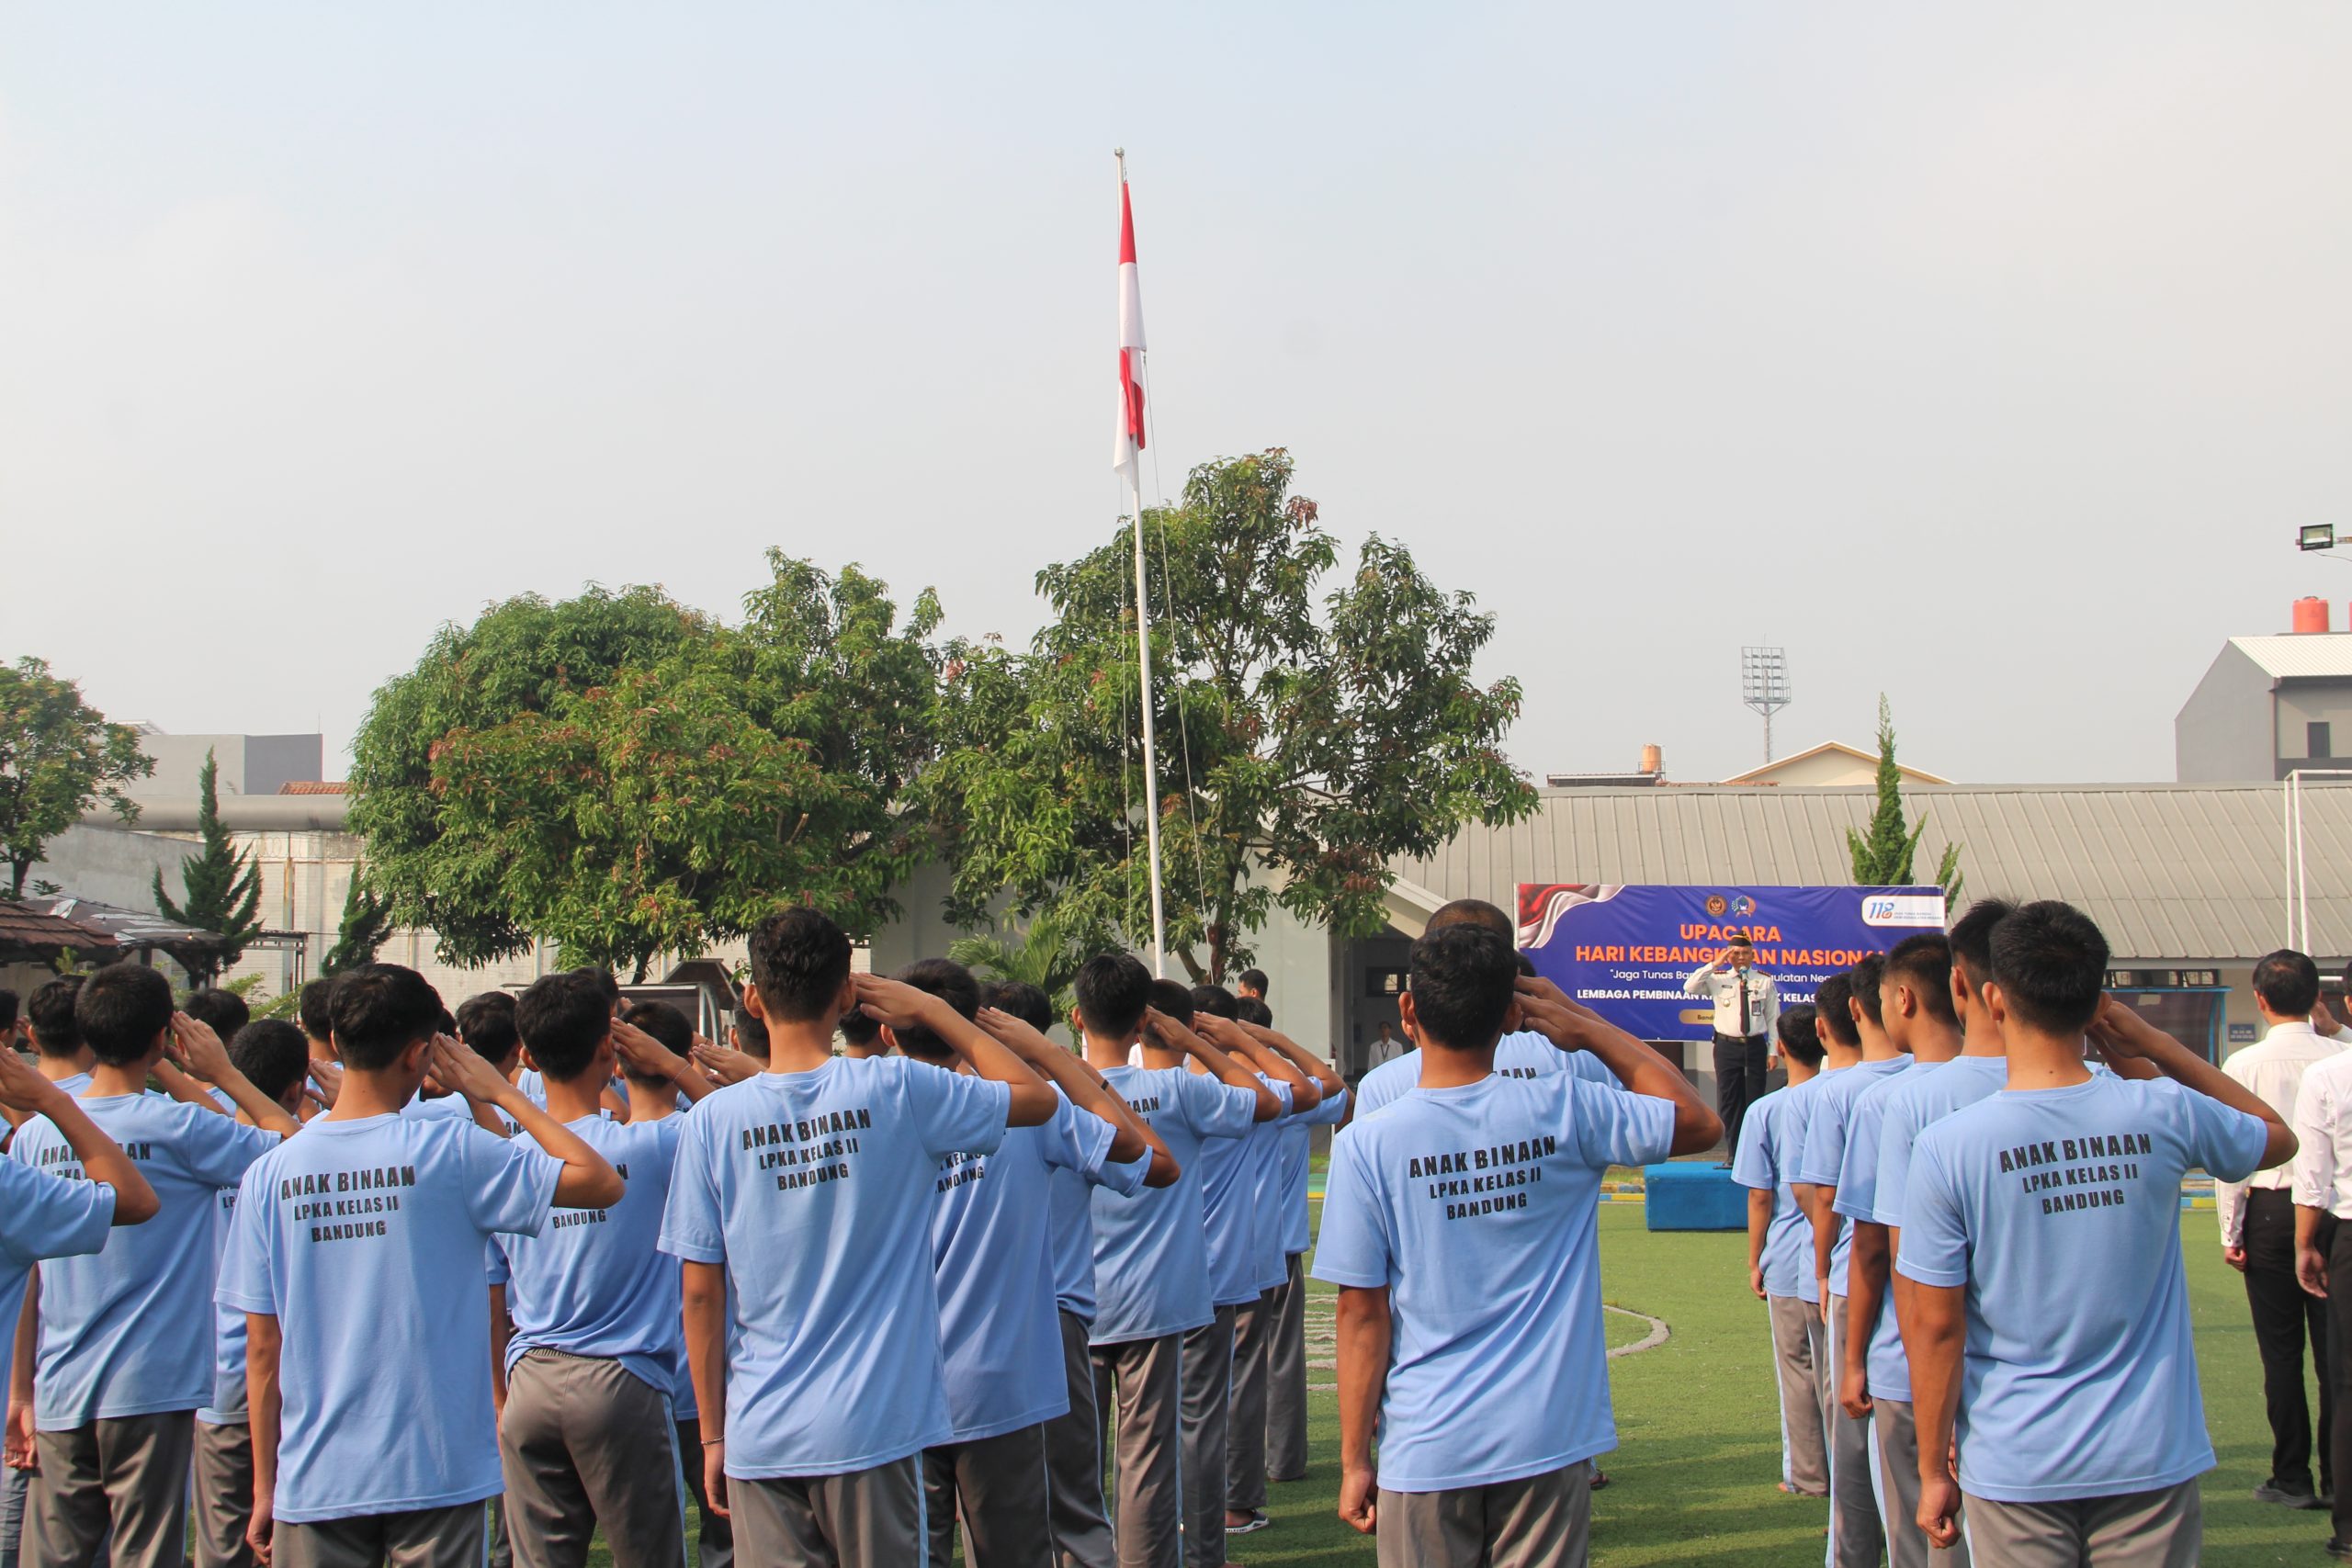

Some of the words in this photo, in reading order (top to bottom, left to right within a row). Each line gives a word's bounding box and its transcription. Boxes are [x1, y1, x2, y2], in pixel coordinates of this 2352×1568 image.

[1869, 902, 1894, 919] 118
[1576, 945, 1624, 962] HARI
[1781, 949, 1884, 965] NASION
[1642, 970, 1673, 979] Tunas
[1577, 989, 1631, 999] LEMBAGA
[742, 1123, 794, 1150] ANAK
[797, 1109, 871, 1142] BINAAN
[759, 1150, 797, 1170] LPKA
[800, 1140, 843, 1164] KELAS
[846, 1138, 858, 1153] II
[1409, 1152, 1468, 1178] ANAK
[1475, 1135, 1555, 1169] BINAAN
[1999, 1141, 2058, 1173] ANAK
[2062, 1134, 2152, 1161] BINAAN
[281, 1173, 331, 1200] ANAK
[337, 1166, 415, 1191] BINAAN
[777, 1163, 849, 1190] BANDUNG
[935, 1167, 984, 1193] ANDUNG
[1430, 1179, 1469, 1199] LPKA
[1474, 1169, 1526, 1193] KELAS
[1530, 1167, 1541, 1182] II
[2022, 1170, 2063, 1193] LPKA
[2065, 1164, 2120, 1185] KELAS
[2124, 1163, 2138, 1179] II
[294, 1201, 333, 1220] LPKA
[336, 1197, 383, 1215] KELAS
[387, 1196, 399, 1211] II
[1446, 1192, 1527, 1220] BANDUNG
[2041, 1189, 2124, 1215] BANDUNG
[311, 1220, 387, 1242] BANDUNG
[553, 1210, 606, 1229] BANDUNG
